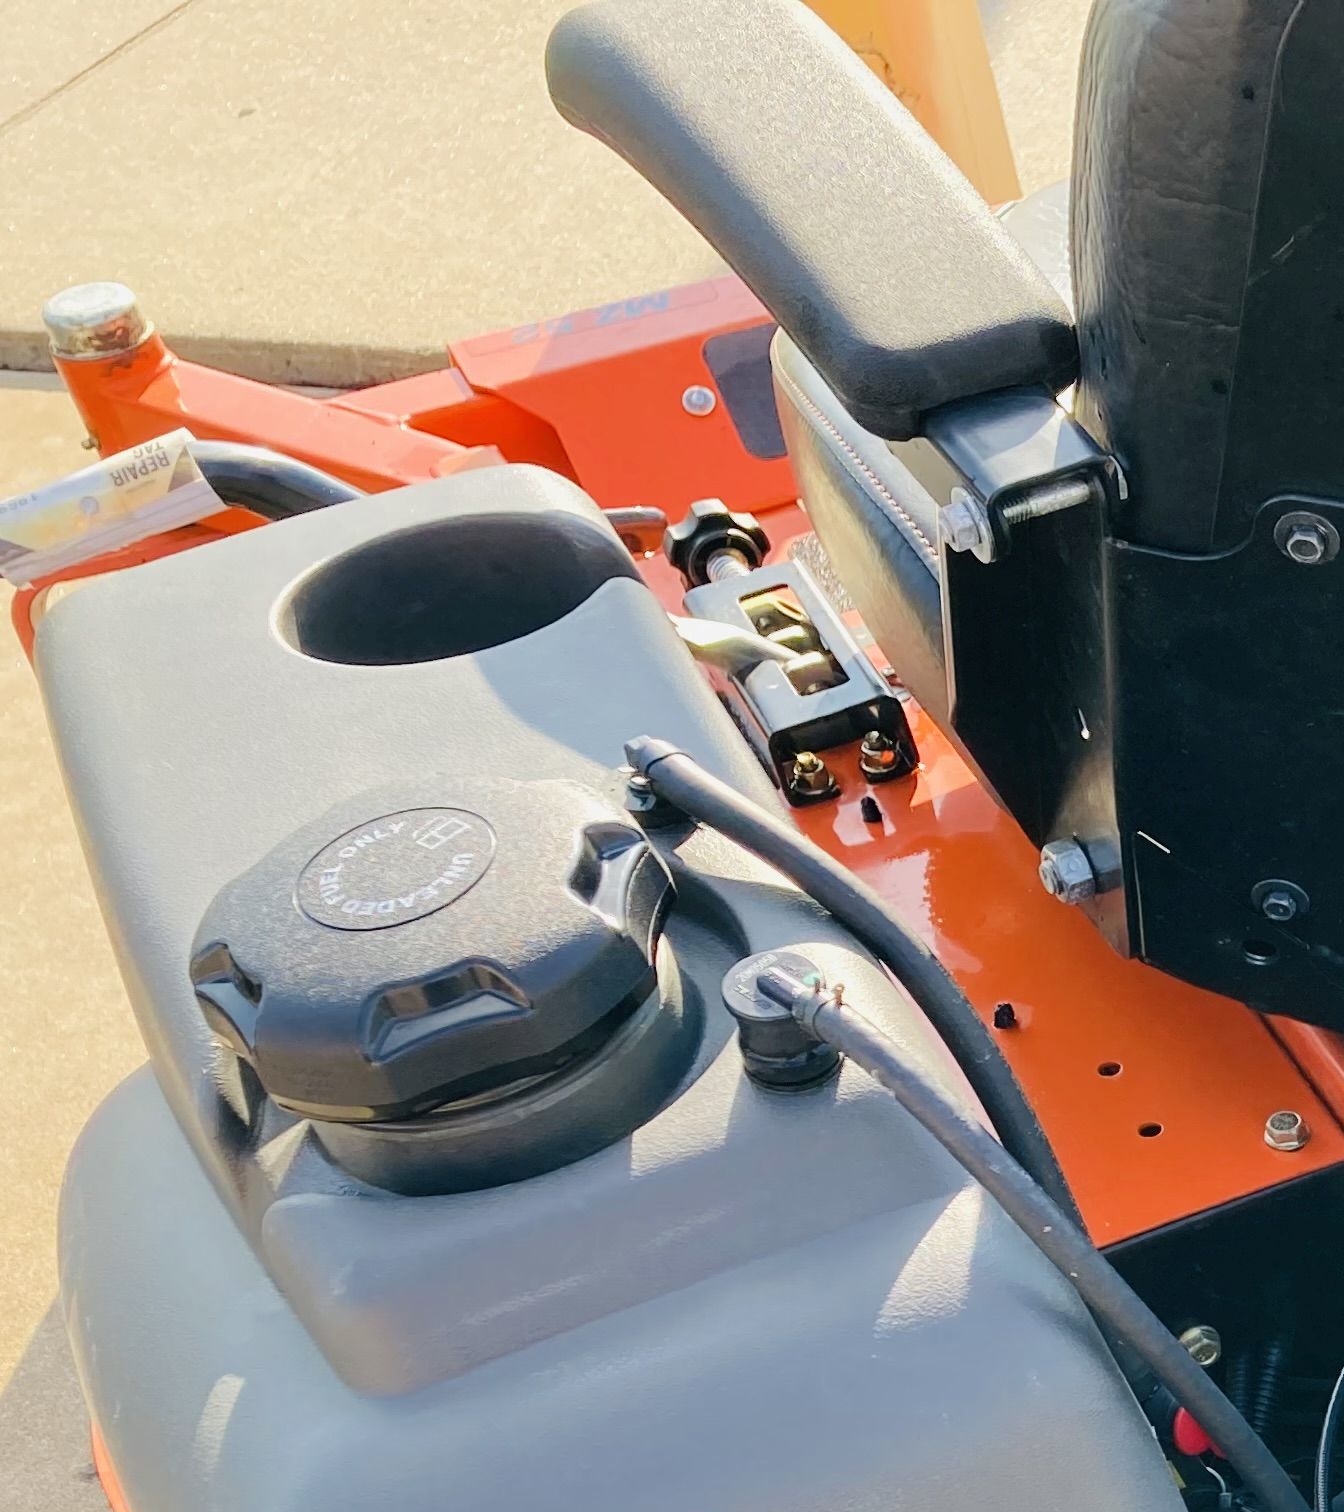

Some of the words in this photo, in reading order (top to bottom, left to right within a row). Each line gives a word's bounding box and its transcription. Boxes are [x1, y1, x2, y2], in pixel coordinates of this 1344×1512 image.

[109, 451, 171, 487] REPAIR
[338, 821, 405, 859] ONLY
[319, 863, 345, 904] FUEL
[341, 853, 475, 915] UNLEADED
